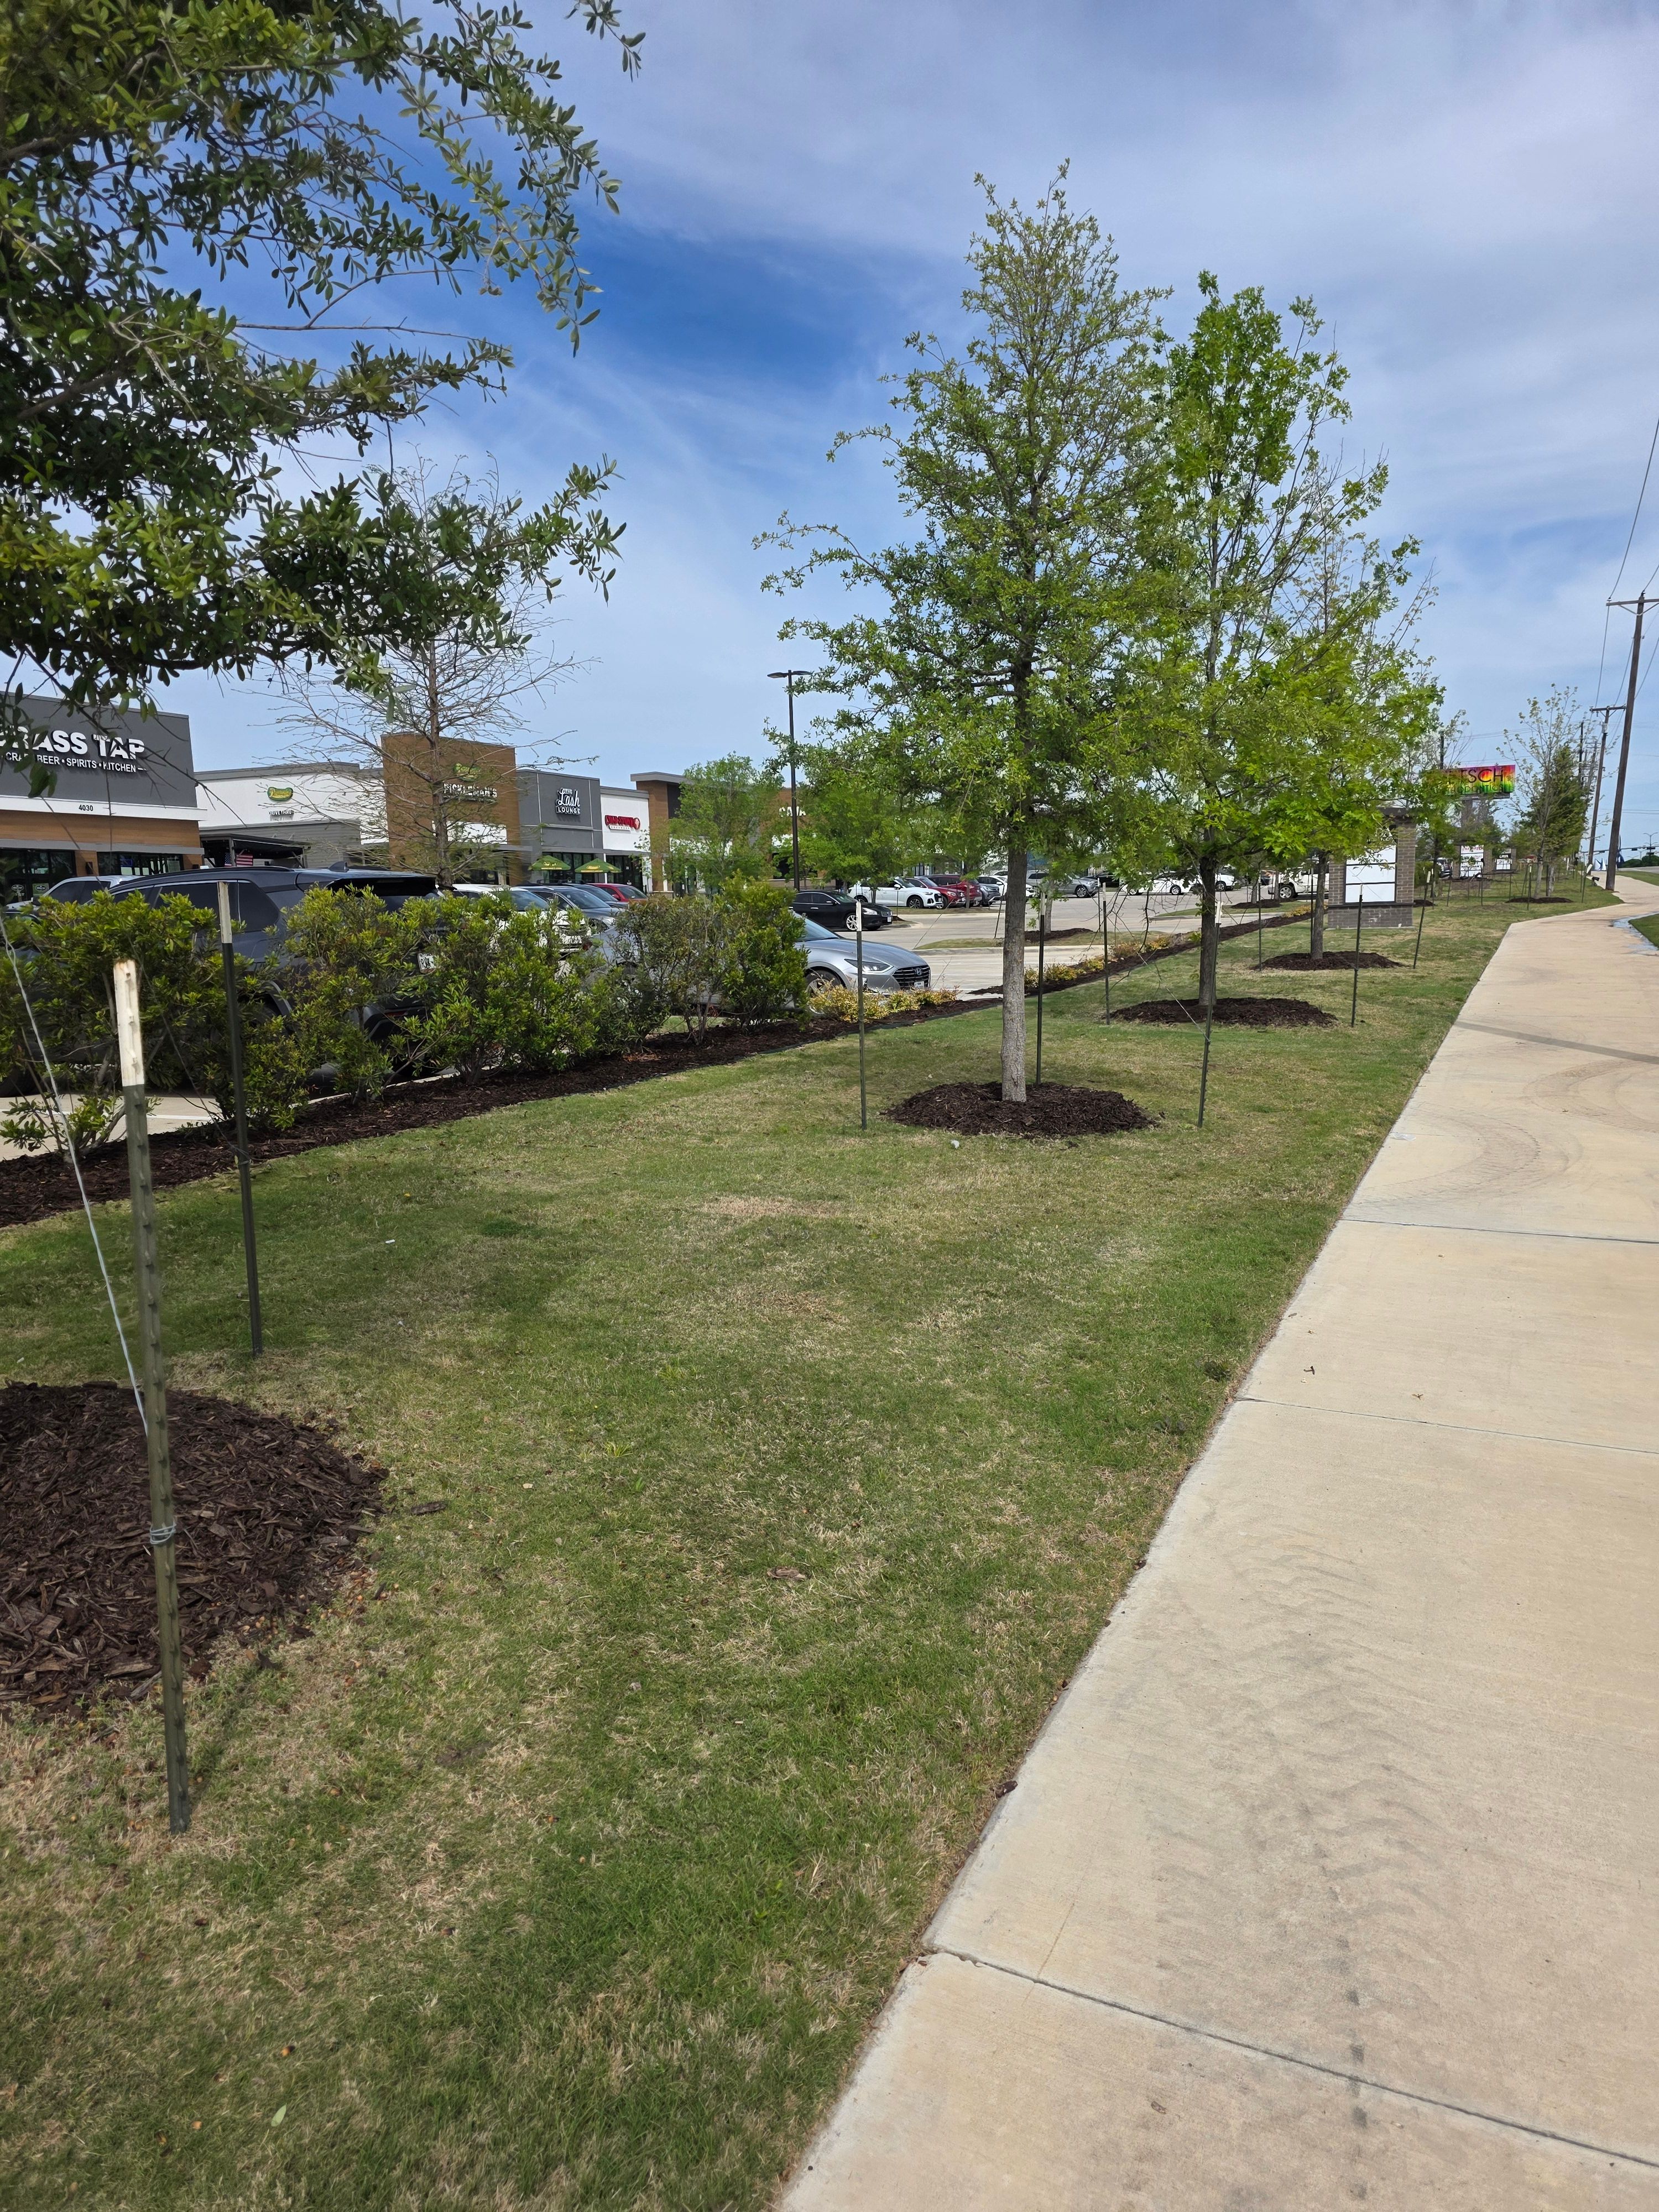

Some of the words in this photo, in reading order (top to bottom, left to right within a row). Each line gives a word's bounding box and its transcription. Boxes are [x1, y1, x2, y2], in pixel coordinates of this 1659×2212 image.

[0, 726, 88, 755] RASS
[93, 734, 145, 760] TAP
[6, 752, 30, 762] CRA
[36, 754, 60, 765] BEER
[66, 758, 97, 769] SPIRITS
[103, 761, 136, 773] KITCHEN
[558, 788, 580, 807] Lash
